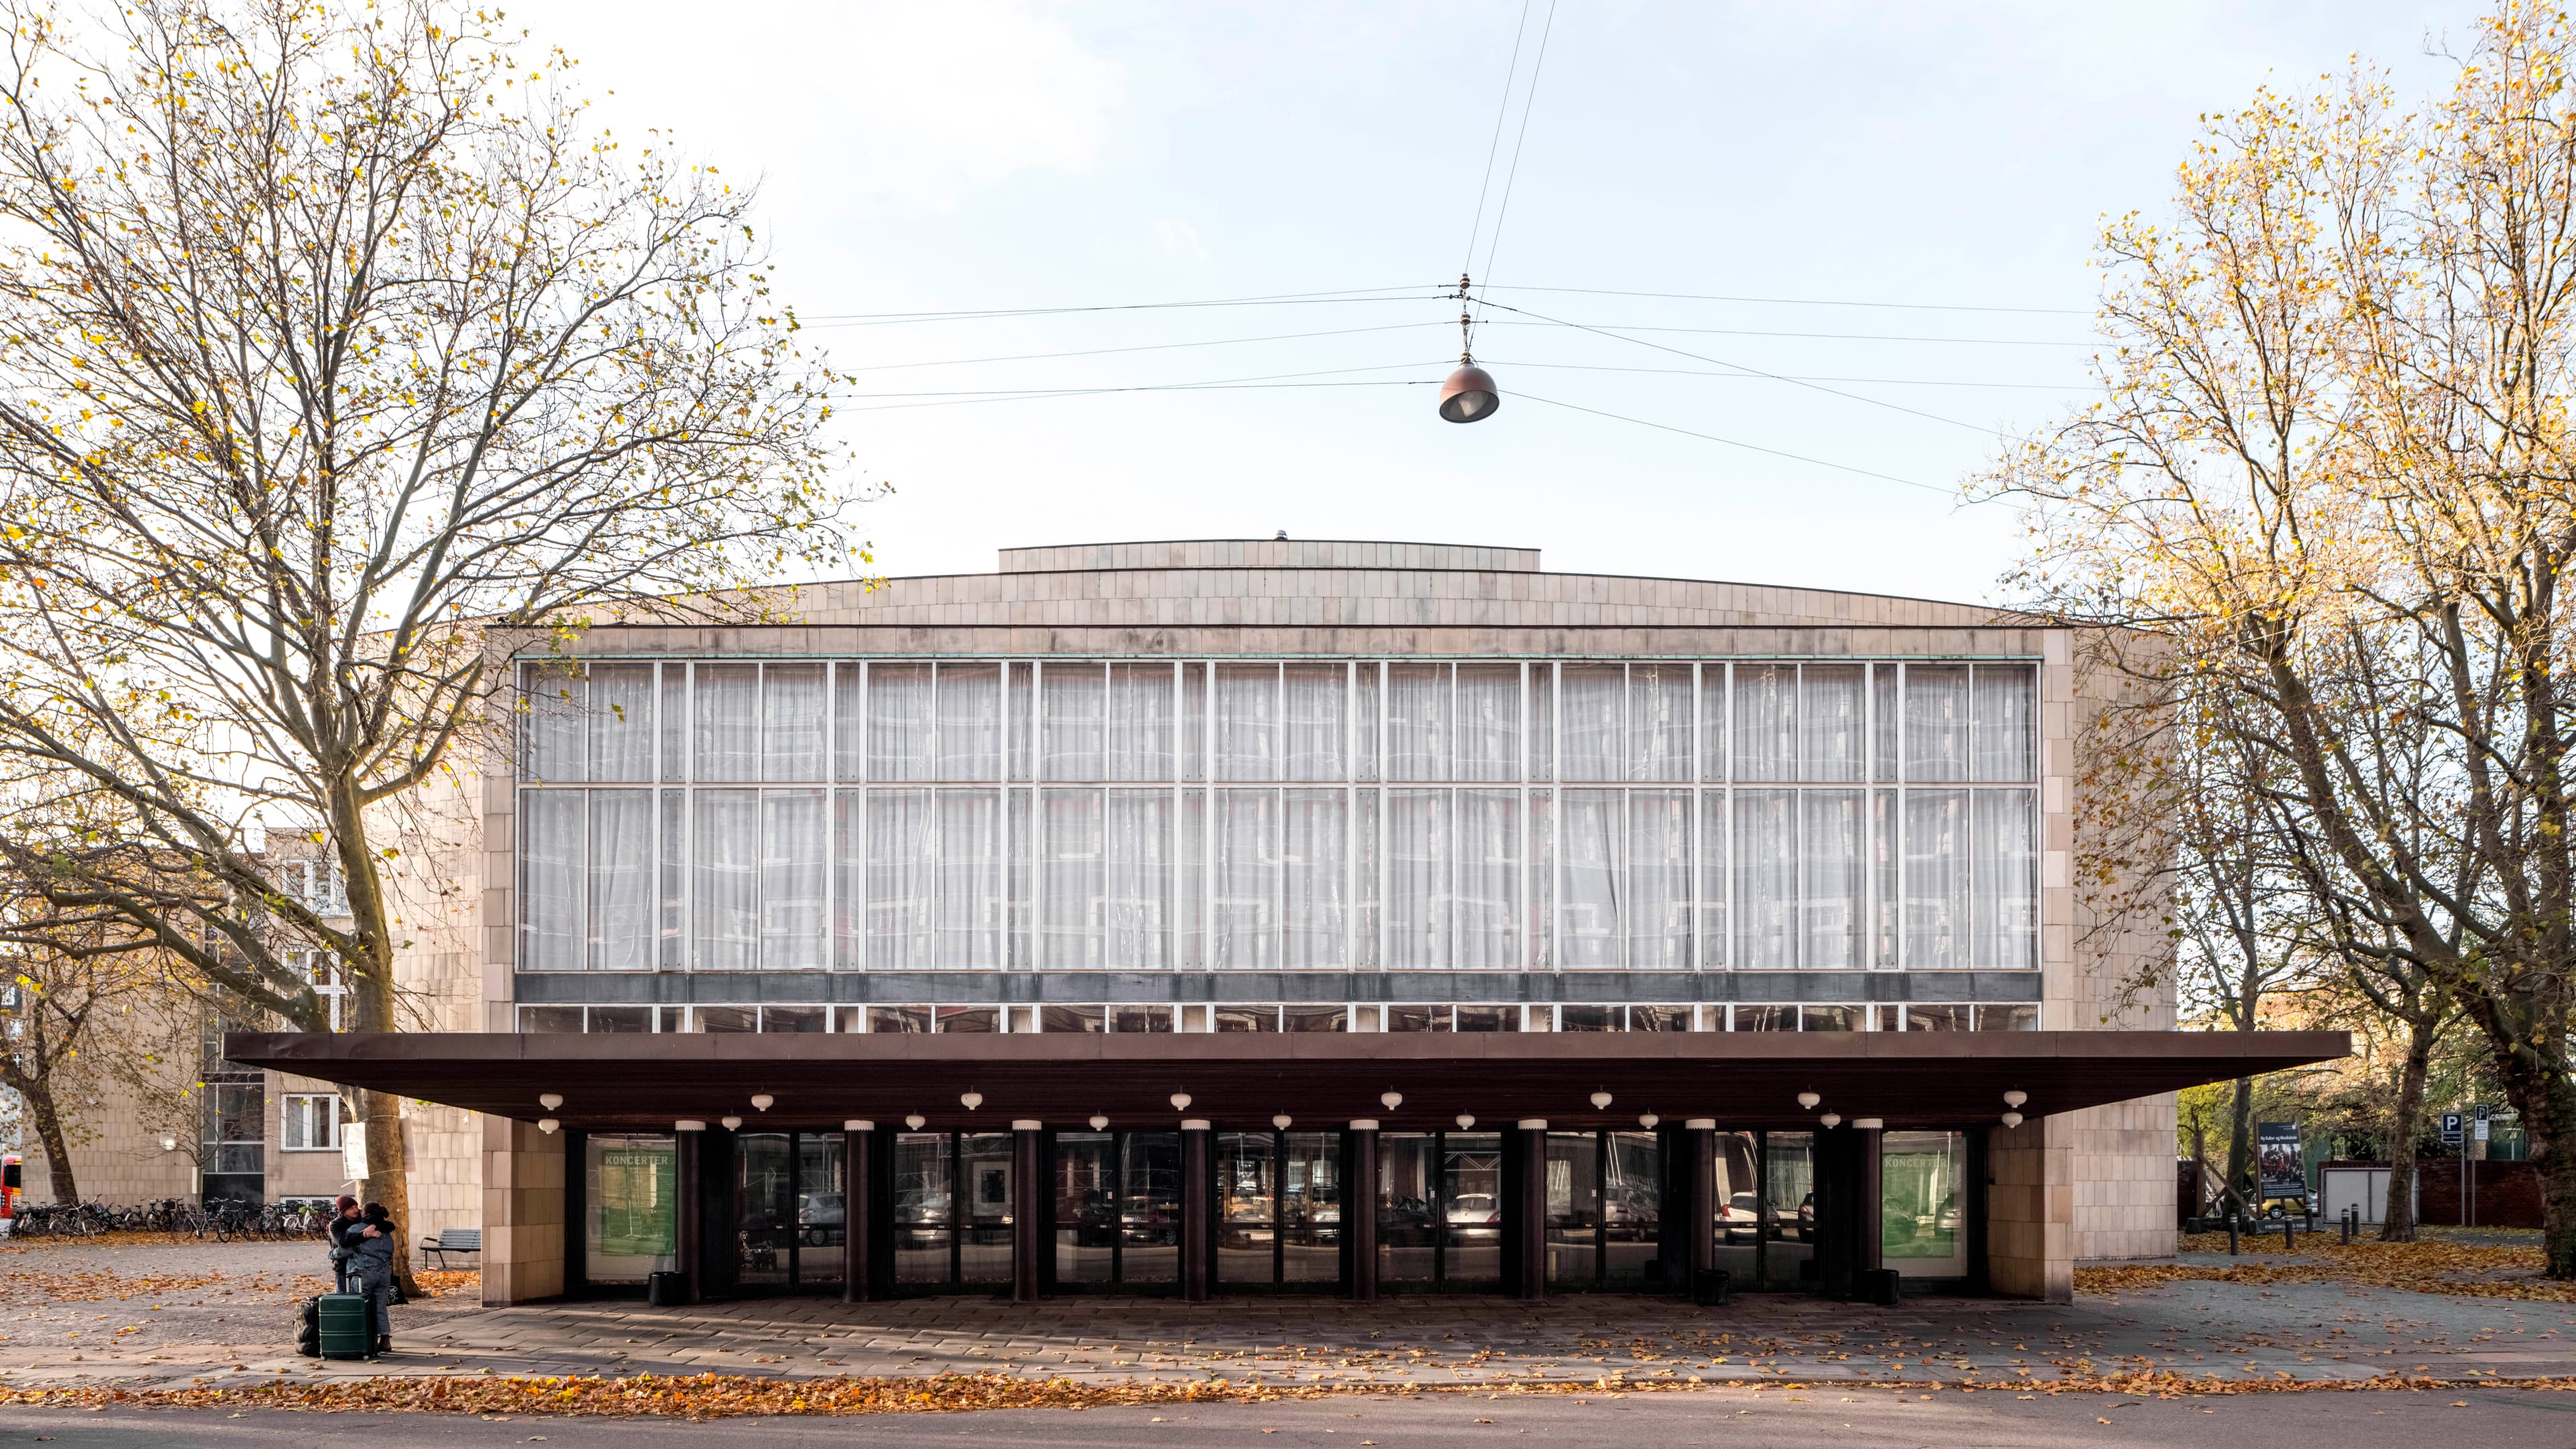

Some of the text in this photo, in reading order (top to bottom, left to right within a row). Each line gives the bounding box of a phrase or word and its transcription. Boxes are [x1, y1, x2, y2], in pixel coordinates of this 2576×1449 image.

[2447, 1116, 2458, 1130] P
[605, 1156, 668, 1165] KONCERTER
[1884, 1159, 1947, 1168] KONCERTER
